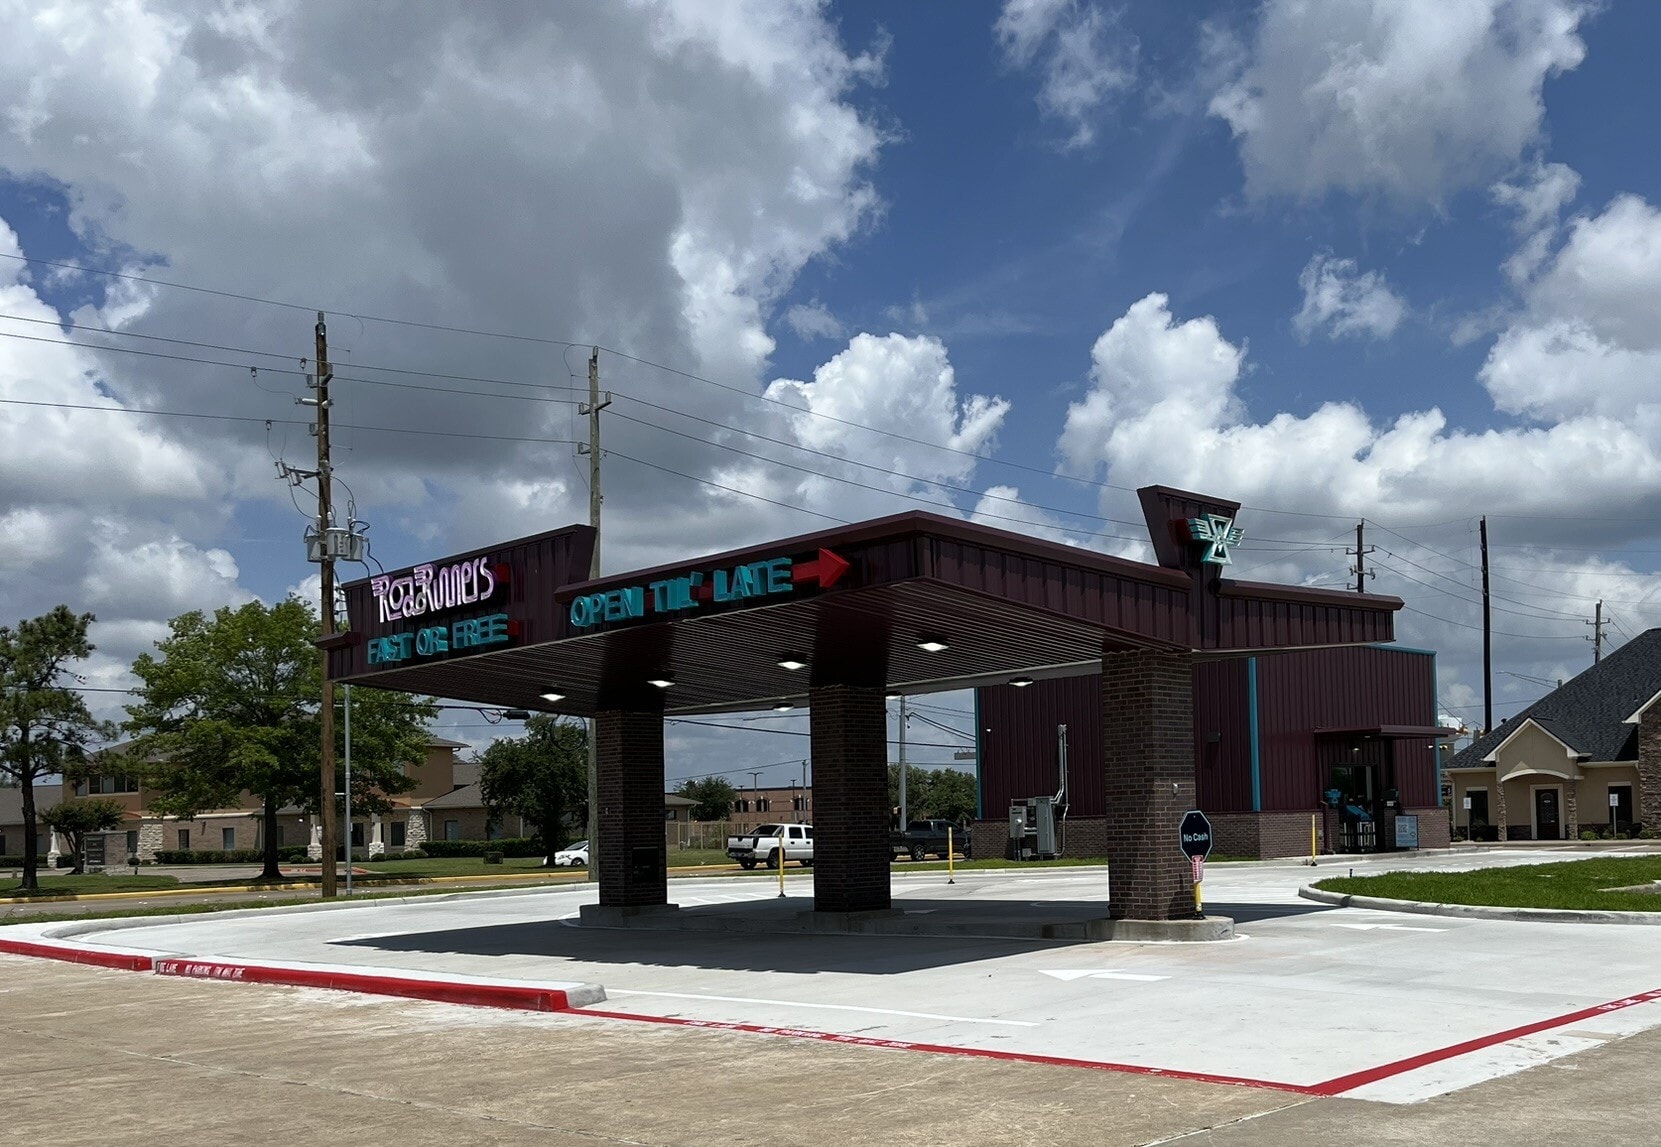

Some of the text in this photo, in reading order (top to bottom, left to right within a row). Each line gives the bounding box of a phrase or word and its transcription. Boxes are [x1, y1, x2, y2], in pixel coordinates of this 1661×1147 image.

[570, 586, 644, 627] OPEN
[713, 557, 793, 602] LATE
[367, 613, 509, 665] FAST OR FREE
[1183, 832, 1209, 843] No Cash
